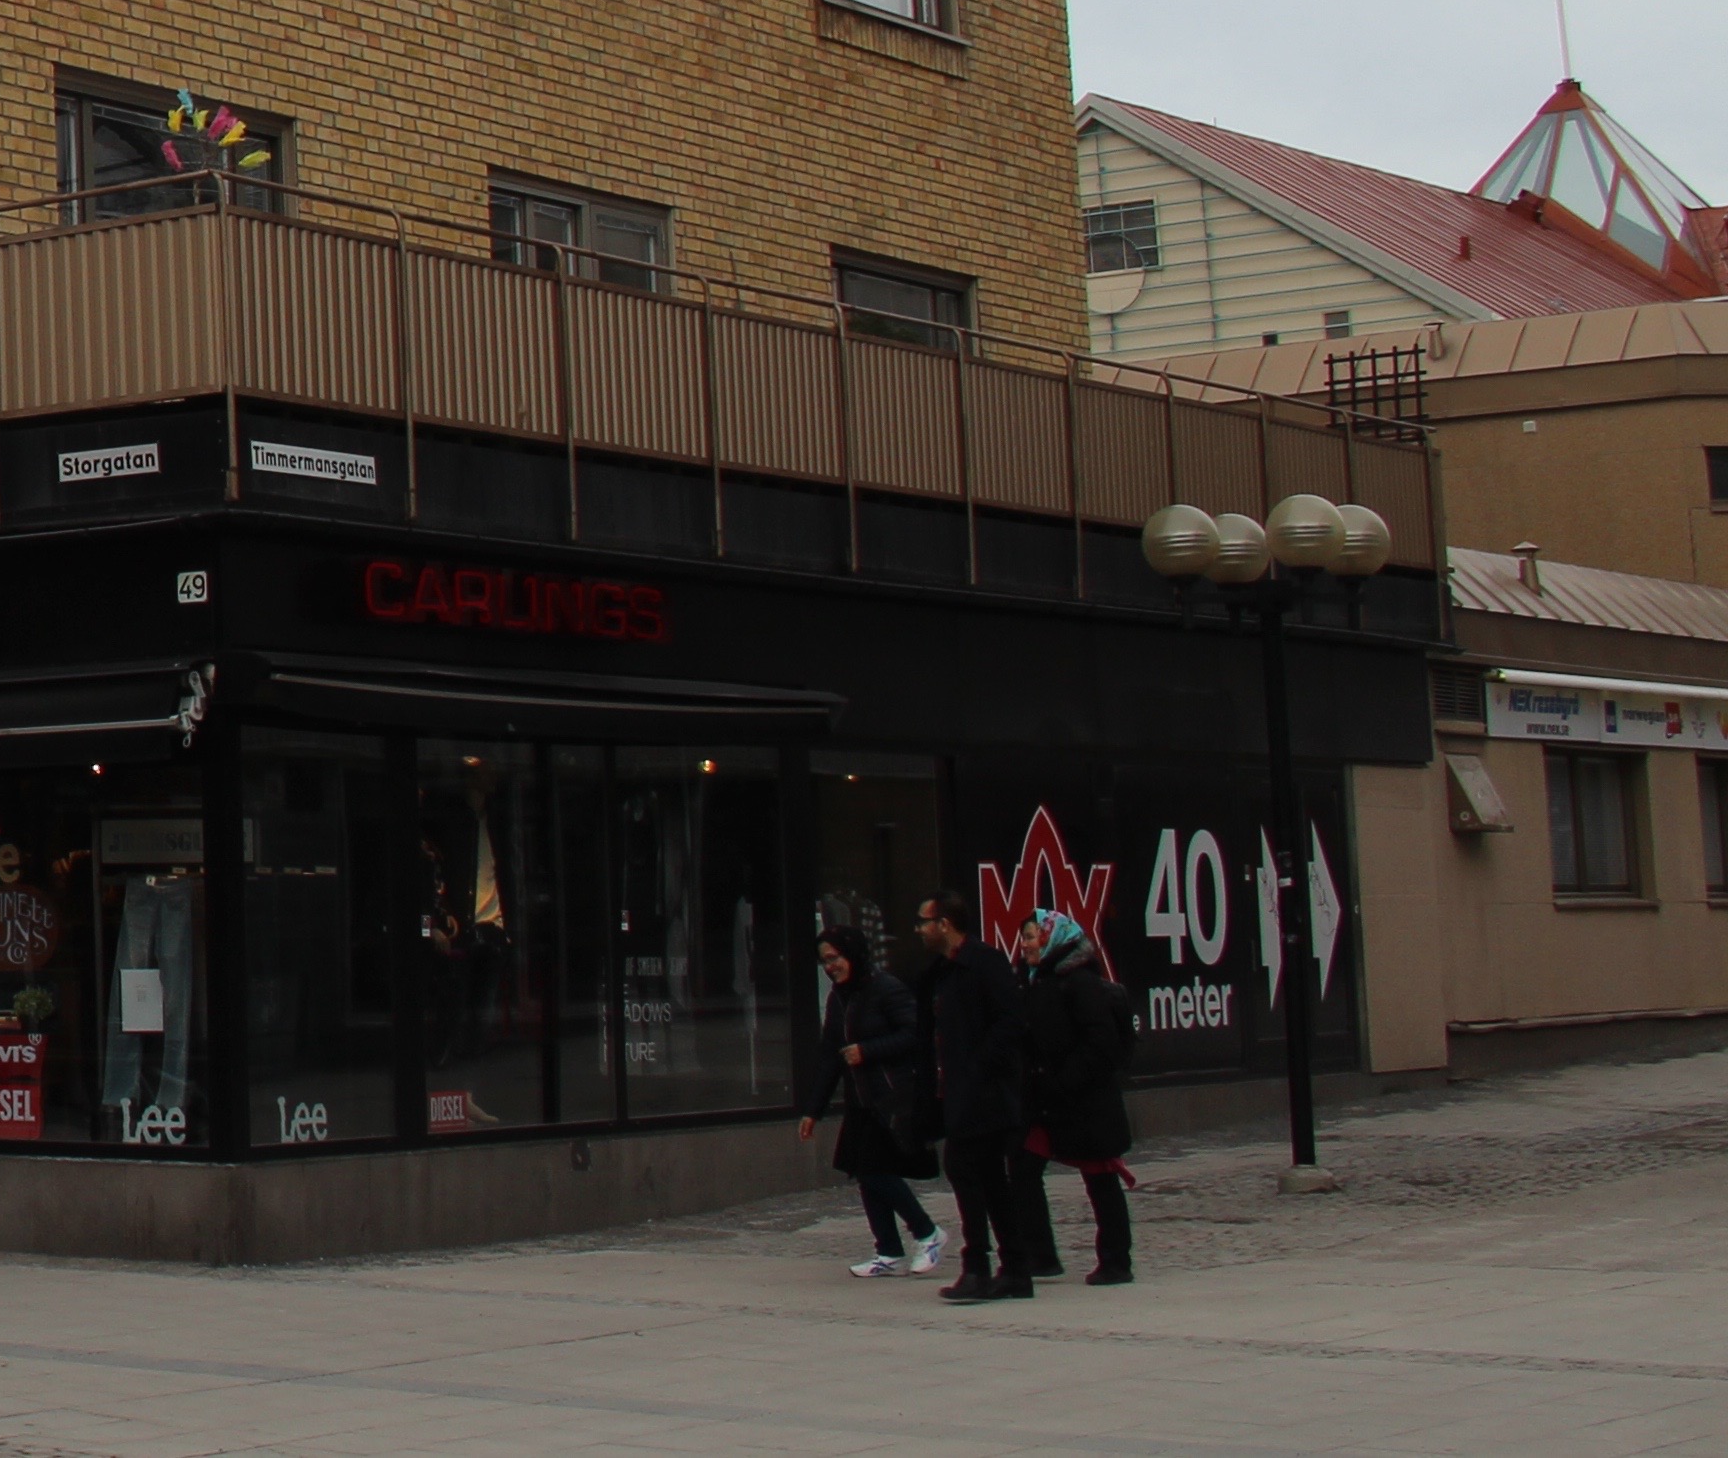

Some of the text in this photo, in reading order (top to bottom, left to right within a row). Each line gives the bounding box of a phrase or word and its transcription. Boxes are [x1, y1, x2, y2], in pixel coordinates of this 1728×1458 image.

[63, 451, 155, 477] Storgatan
[253, 445, 375, 480] Timmermansgatan
[179, 574, 205, 600] 49
[364, 561, 667, 644] CARLINGS
[1145, 828, 1226, 966] 40
[1148, 975, 1231, 1030] meter
[119, 1097, 187, 1146] Lee
[277, 1095, 328, 1144] Lee
[430, 1094, 466, 1122] DIESEL
